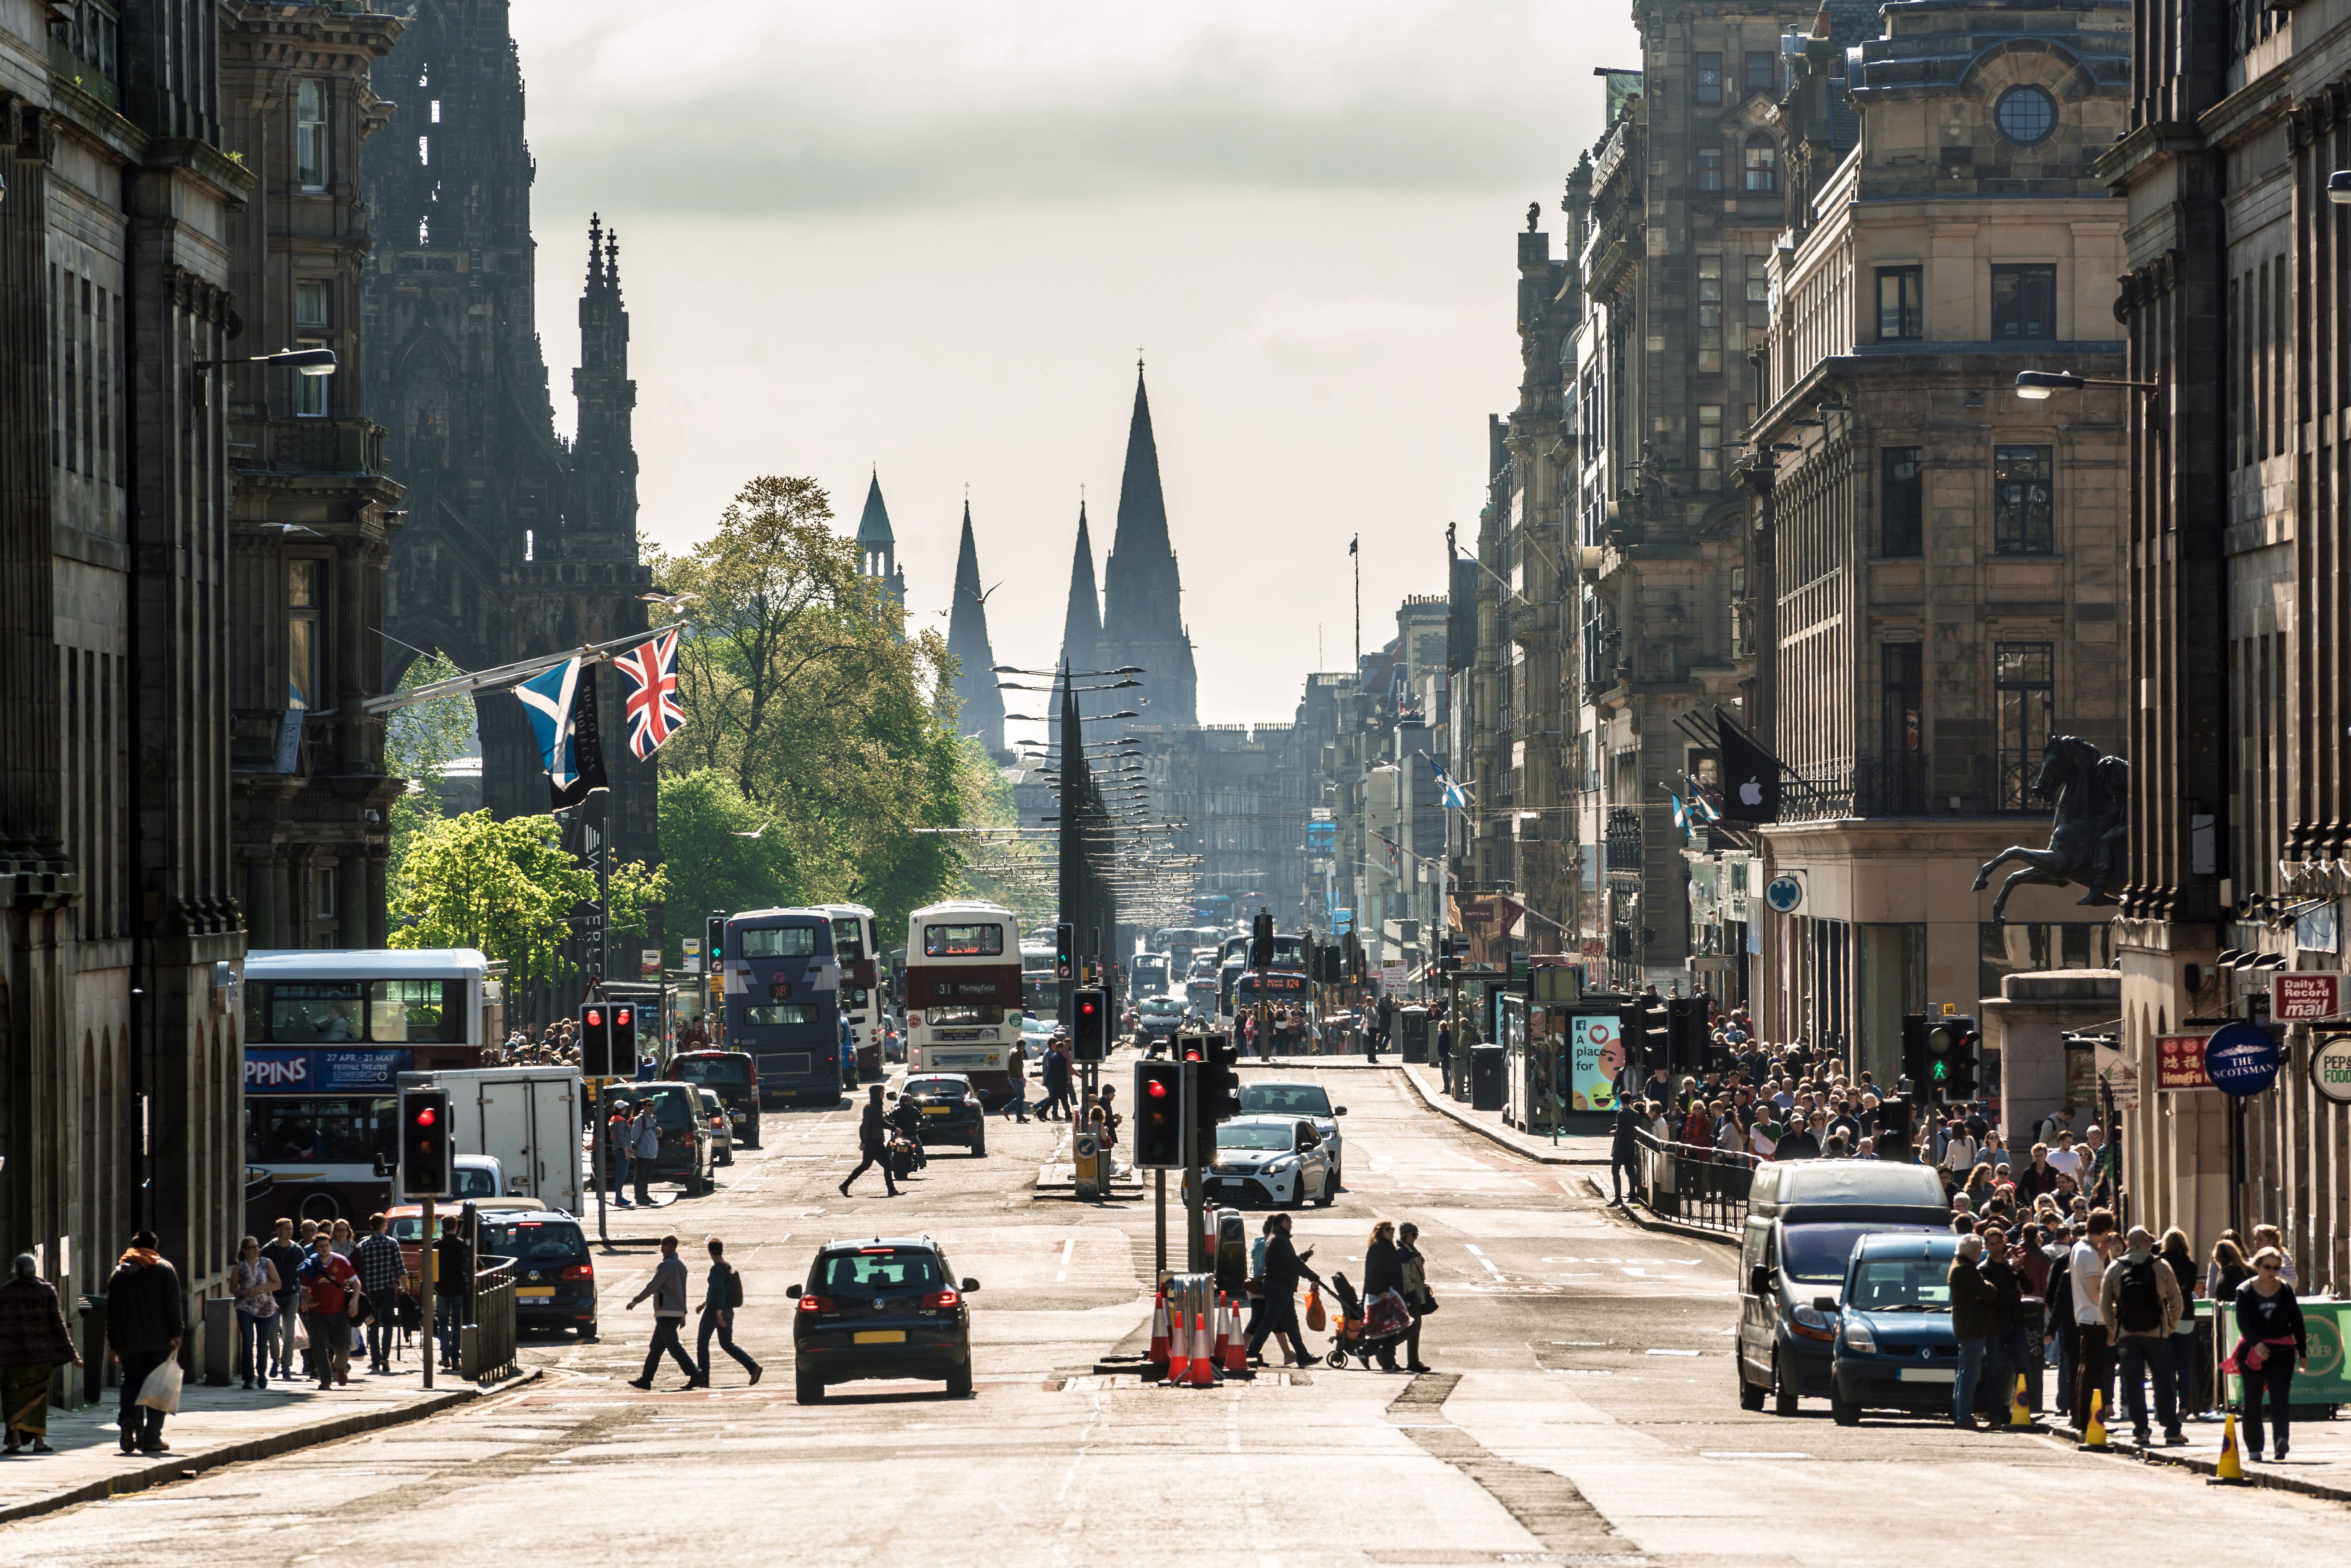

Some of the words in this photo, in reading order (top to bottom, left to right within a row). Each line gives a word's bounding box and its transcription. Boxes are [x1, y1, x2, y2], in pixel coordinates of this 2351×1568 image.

[583, 686, 596, 731] ROCCO
[577, 710, 590, 761] HOTELS
[775, 985, 786, 997] X8
[940, 984, 950, 994] 31
[2284, 980, 2315, 990] Daily
[2285, 988, 2330, 997] Record
[2285, 999, 2328, 1016] mail
[1576, 1035, 1584, 1044] A
[1576, 1046, 1606, 1059] place
[1576, 1061, 1594, 1071] for
[2230, 1056, 2254, 1066] THE
[2213, 1063, 2274, 1079] SCOTSMAN
[2163, 1071, 2202, 1086] HongFu
